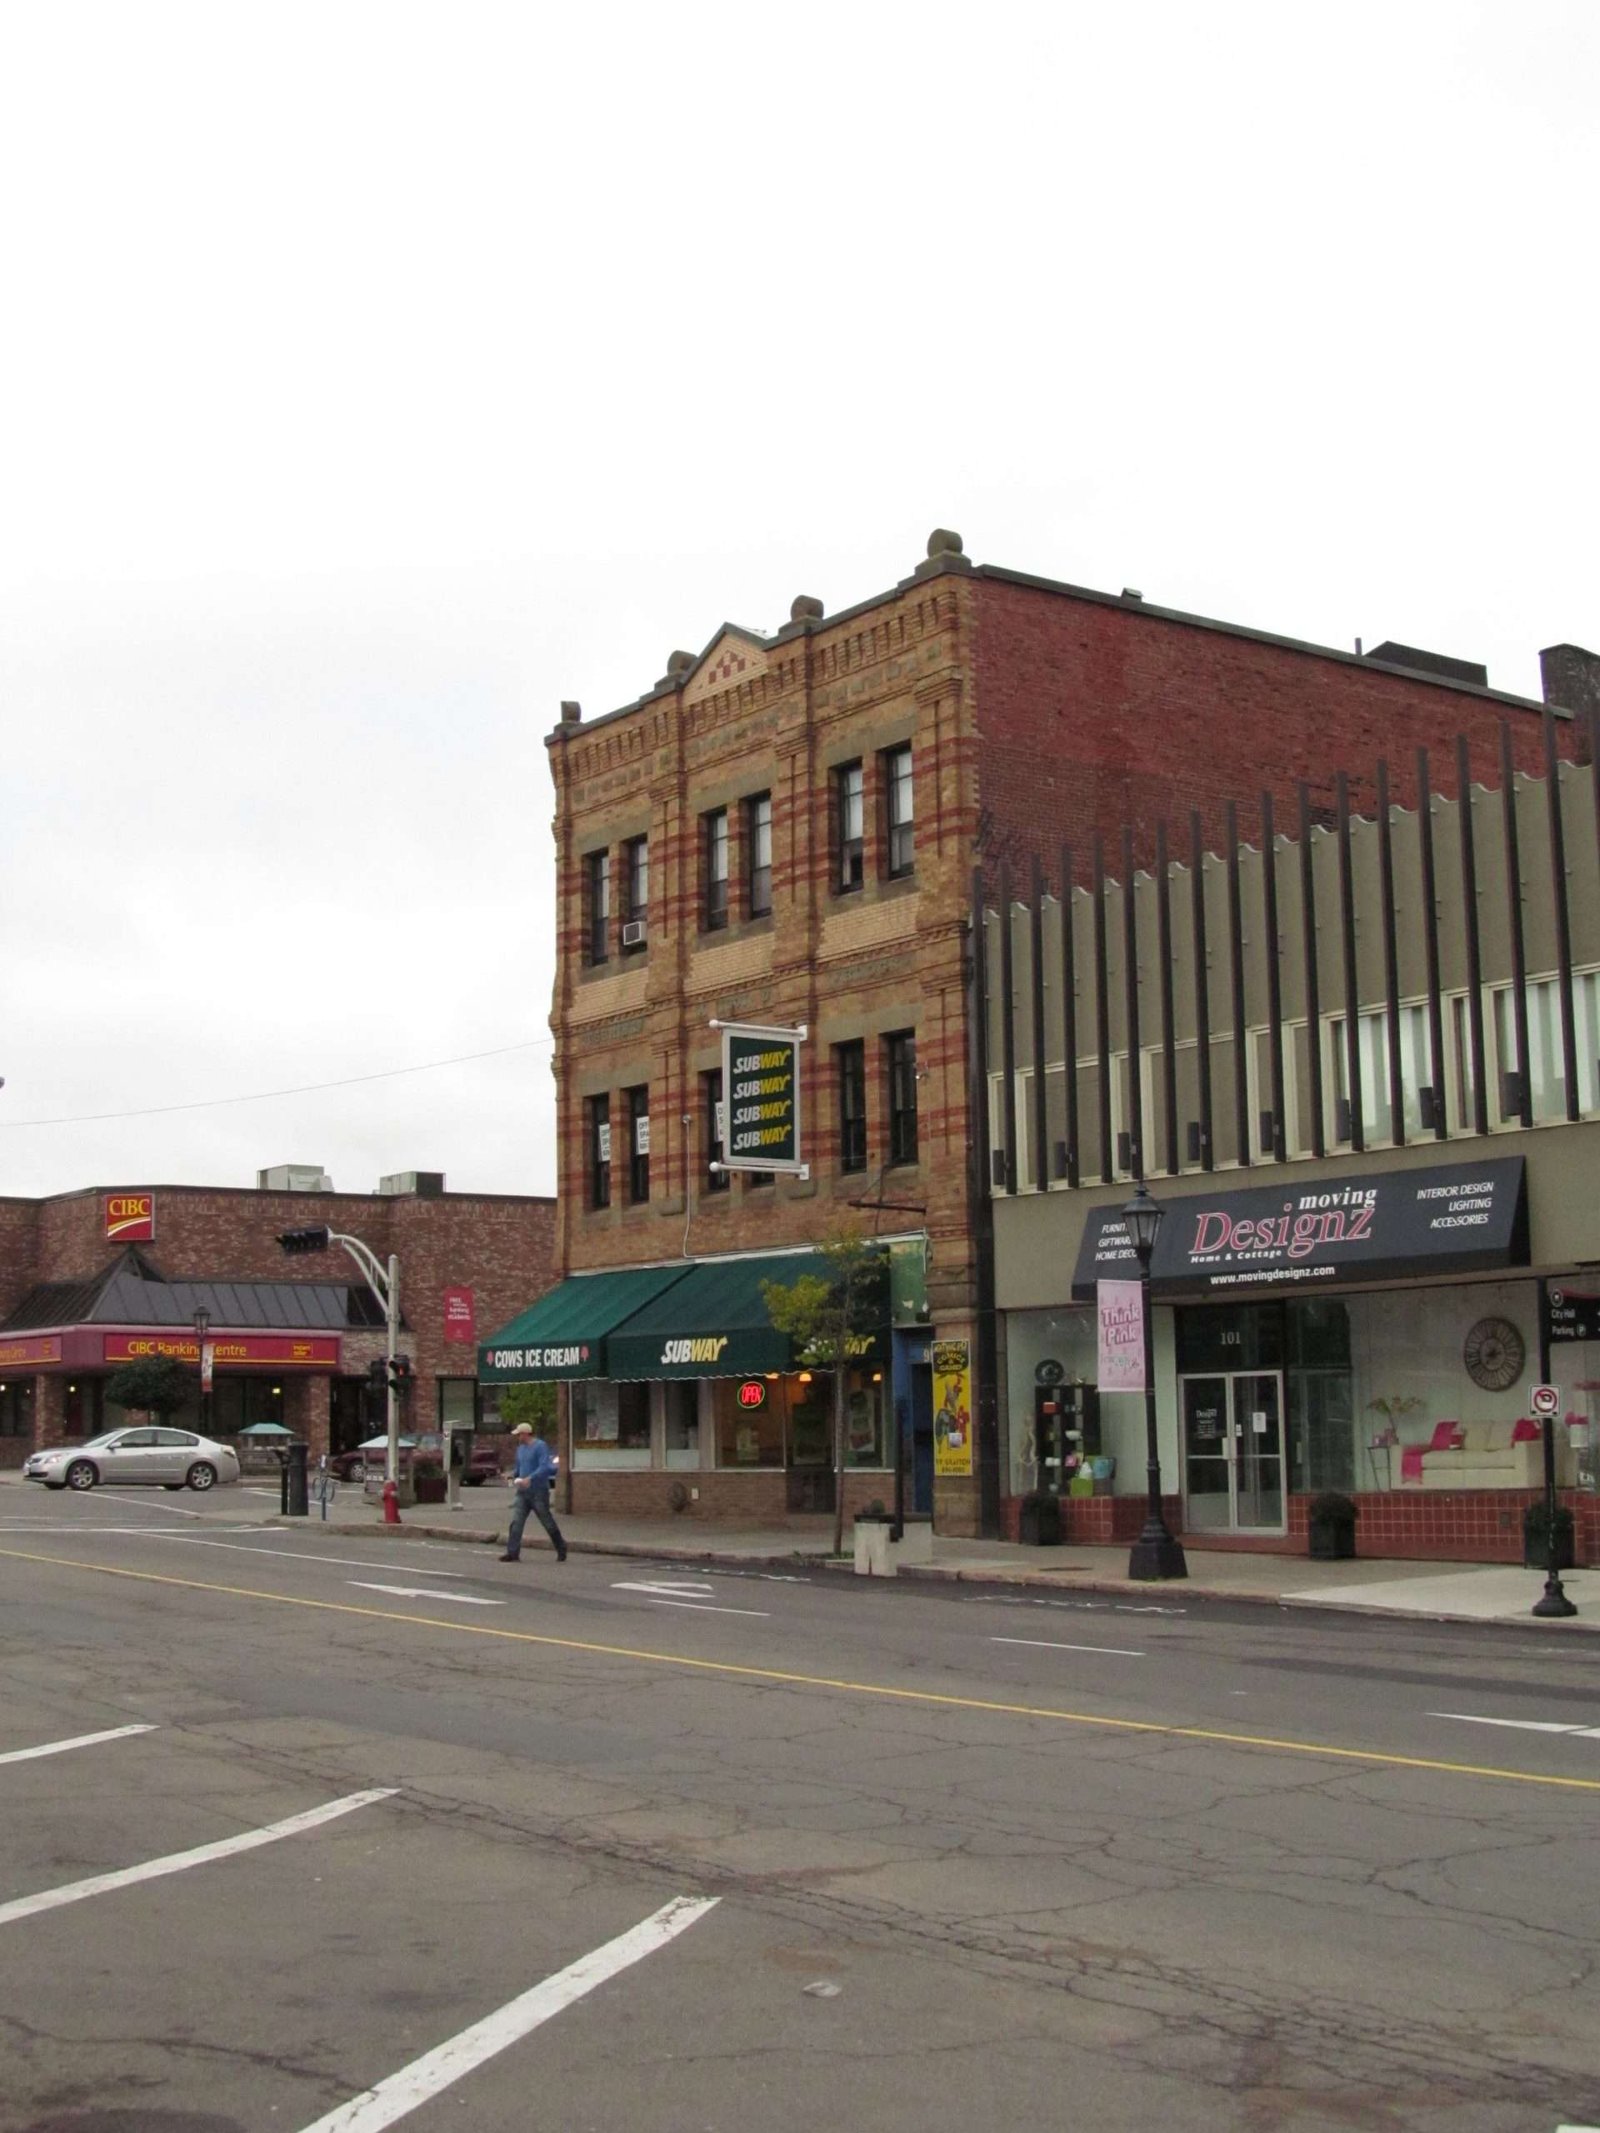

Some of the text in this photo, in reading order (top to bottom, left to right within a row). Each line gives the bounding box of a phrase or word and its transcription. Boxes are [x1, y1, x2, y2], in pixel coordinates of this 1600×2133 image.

[733, 1049, 792, 1075] SUBWAY
[733, 1074, 792, 1100] SUBWAY
[733, 1100, 792, 1126] SUBWAY
[733, 1124, 792, 1150] SUBWAY
[1299, 1187, 1378, 1208] moving
[1417, 1181, 1494, 1200] INTERIOR DESIGN
[109, 1199, 150, 1216] CIBC
[1448, 1197, 1492, 1212] LIGHTING
[1101, 1222, 1127, 1234] FURNIT
[1188, 1202, 1376, 1258] Designz
[1430, 1213, 1489, 1229] ACCESSORIES
[1095, 1248, 1138, 1261] HOME DECO
[1190, 1249, 1282, 1264] Home & Cottage
[1210, 1266, 1336, 1285] www.movingdesignz.com
[1102, 1303, 1140, 1328] Think
[1551, 1308, 1576, 1320] City Hall
[1105, 1323, 1137, 1347] Pink
[1220, 1331, 1241, 1345] 101
[1552, 1325, 1575, 1337] Parking
[128, 1341, 154, 1355] CIBC
[213, 1343, 247, 1357] entre
[495, 1346, 580, 1368] COWS ICE CREAM
[661, 1336, 728, 1364] SUBWAY
[742, 1385, 762, 1404] OPEN
